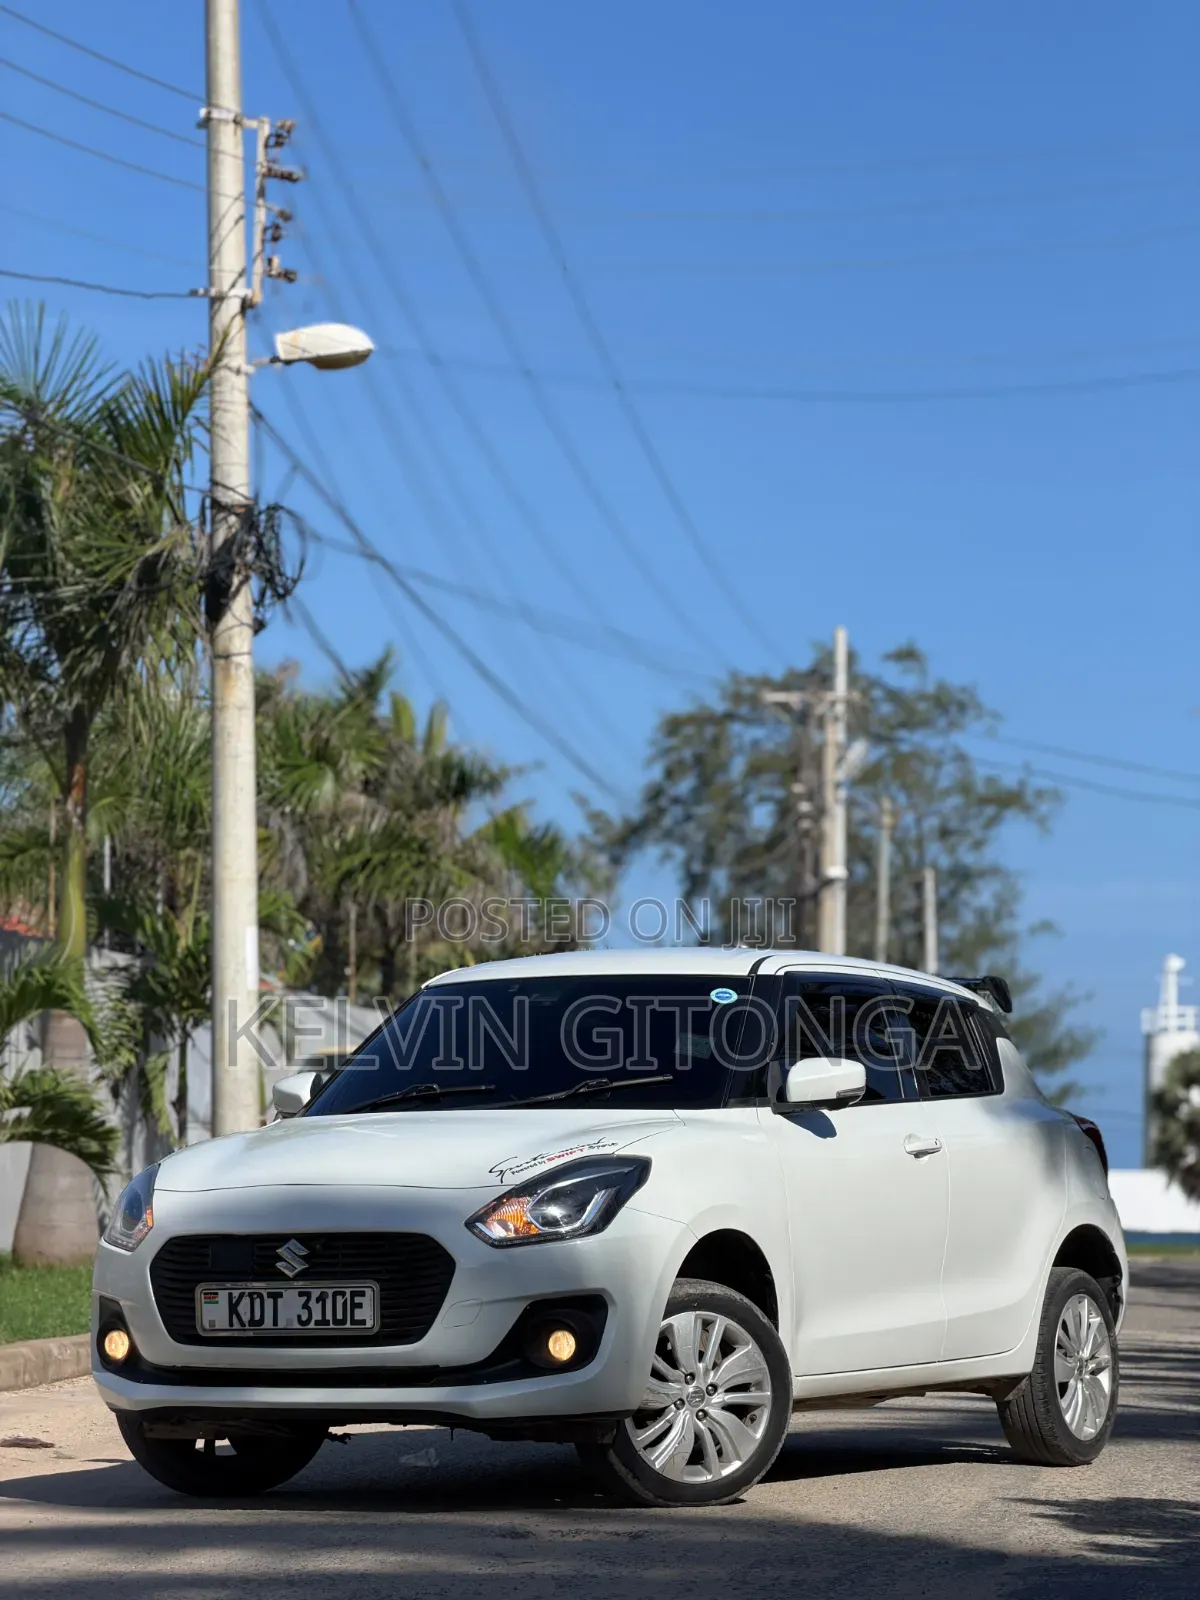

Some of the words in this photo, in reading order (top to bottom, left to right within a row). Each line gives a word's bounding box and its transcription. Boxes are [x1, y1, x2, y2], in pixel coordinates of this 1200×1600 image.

[546, 1148, 585, 1162] SWIFT
[228, 1291, 283, 1327] KDT
[297, 1290, 367, 1327] 310E
